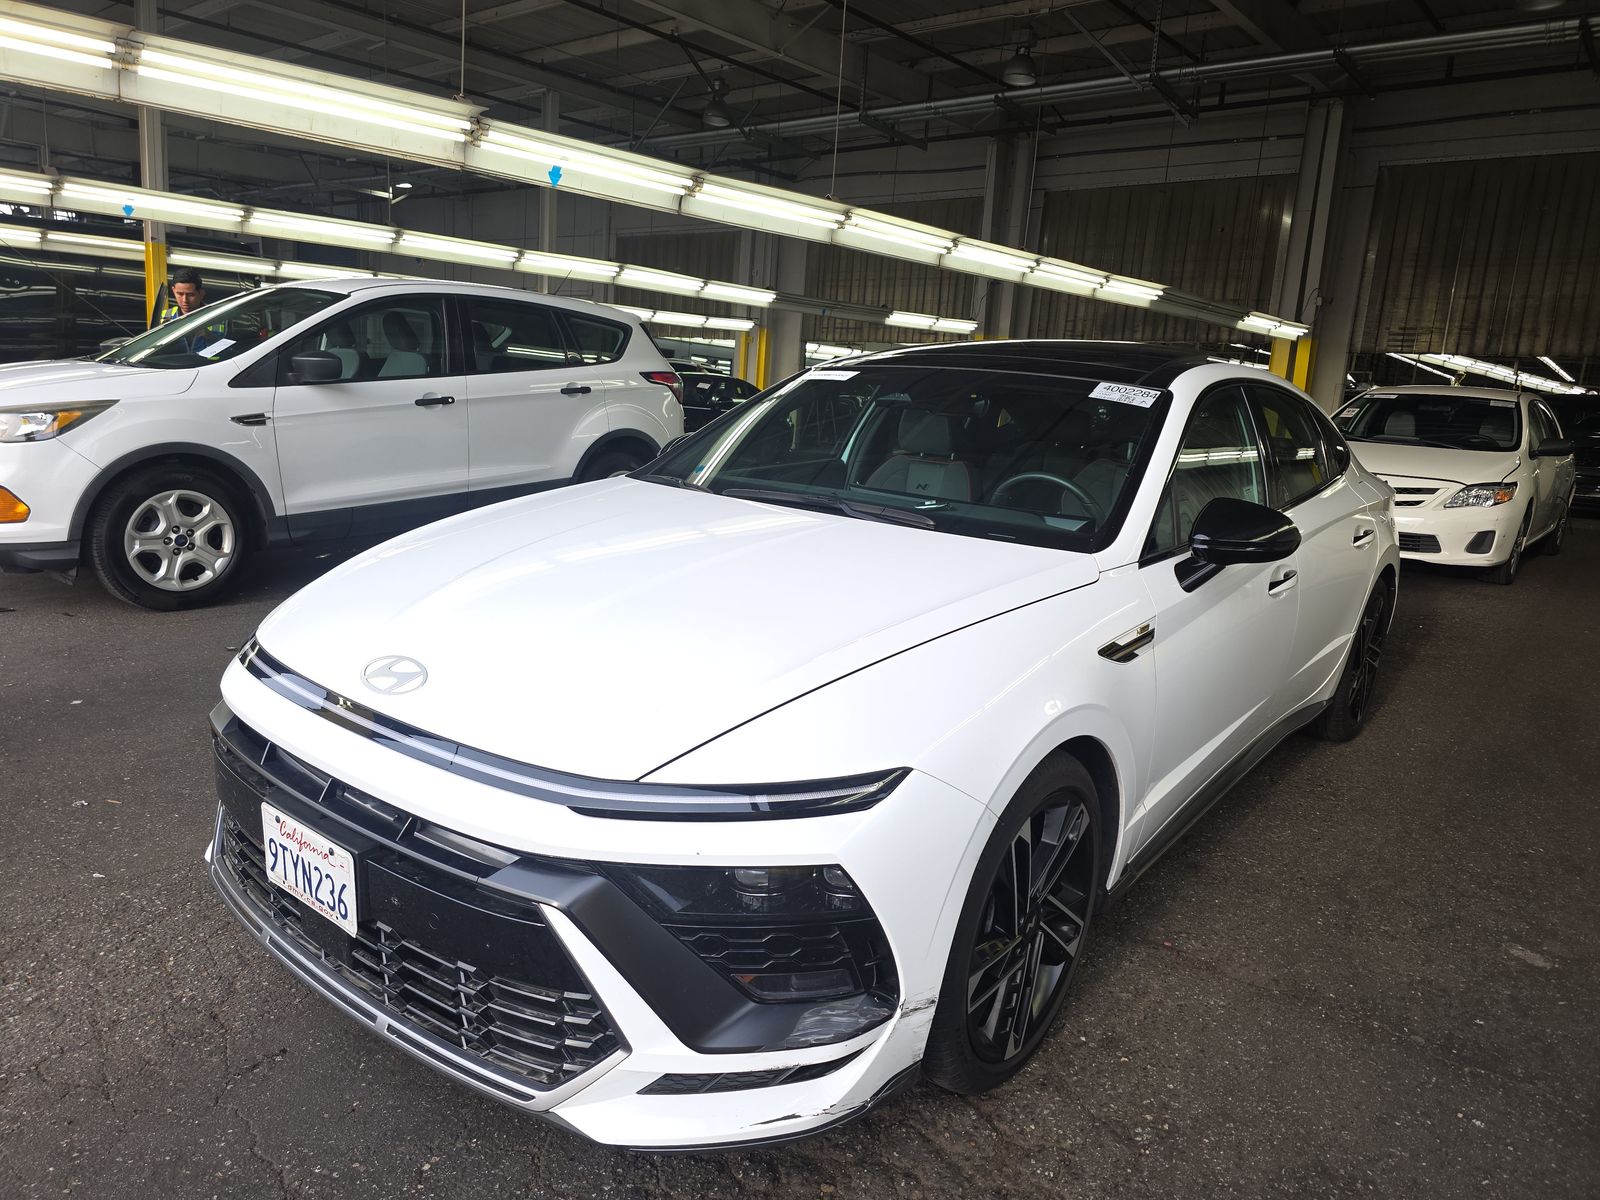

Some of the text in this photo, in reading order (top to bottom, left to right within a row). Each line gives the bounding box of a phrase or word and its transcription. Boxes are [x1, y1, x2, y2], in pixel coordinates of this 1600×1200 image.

[1103, 385, 1158, 399] 4002284
[279, 820, 331, 861] California
[268, 837, 348, 920] 9TYN236
